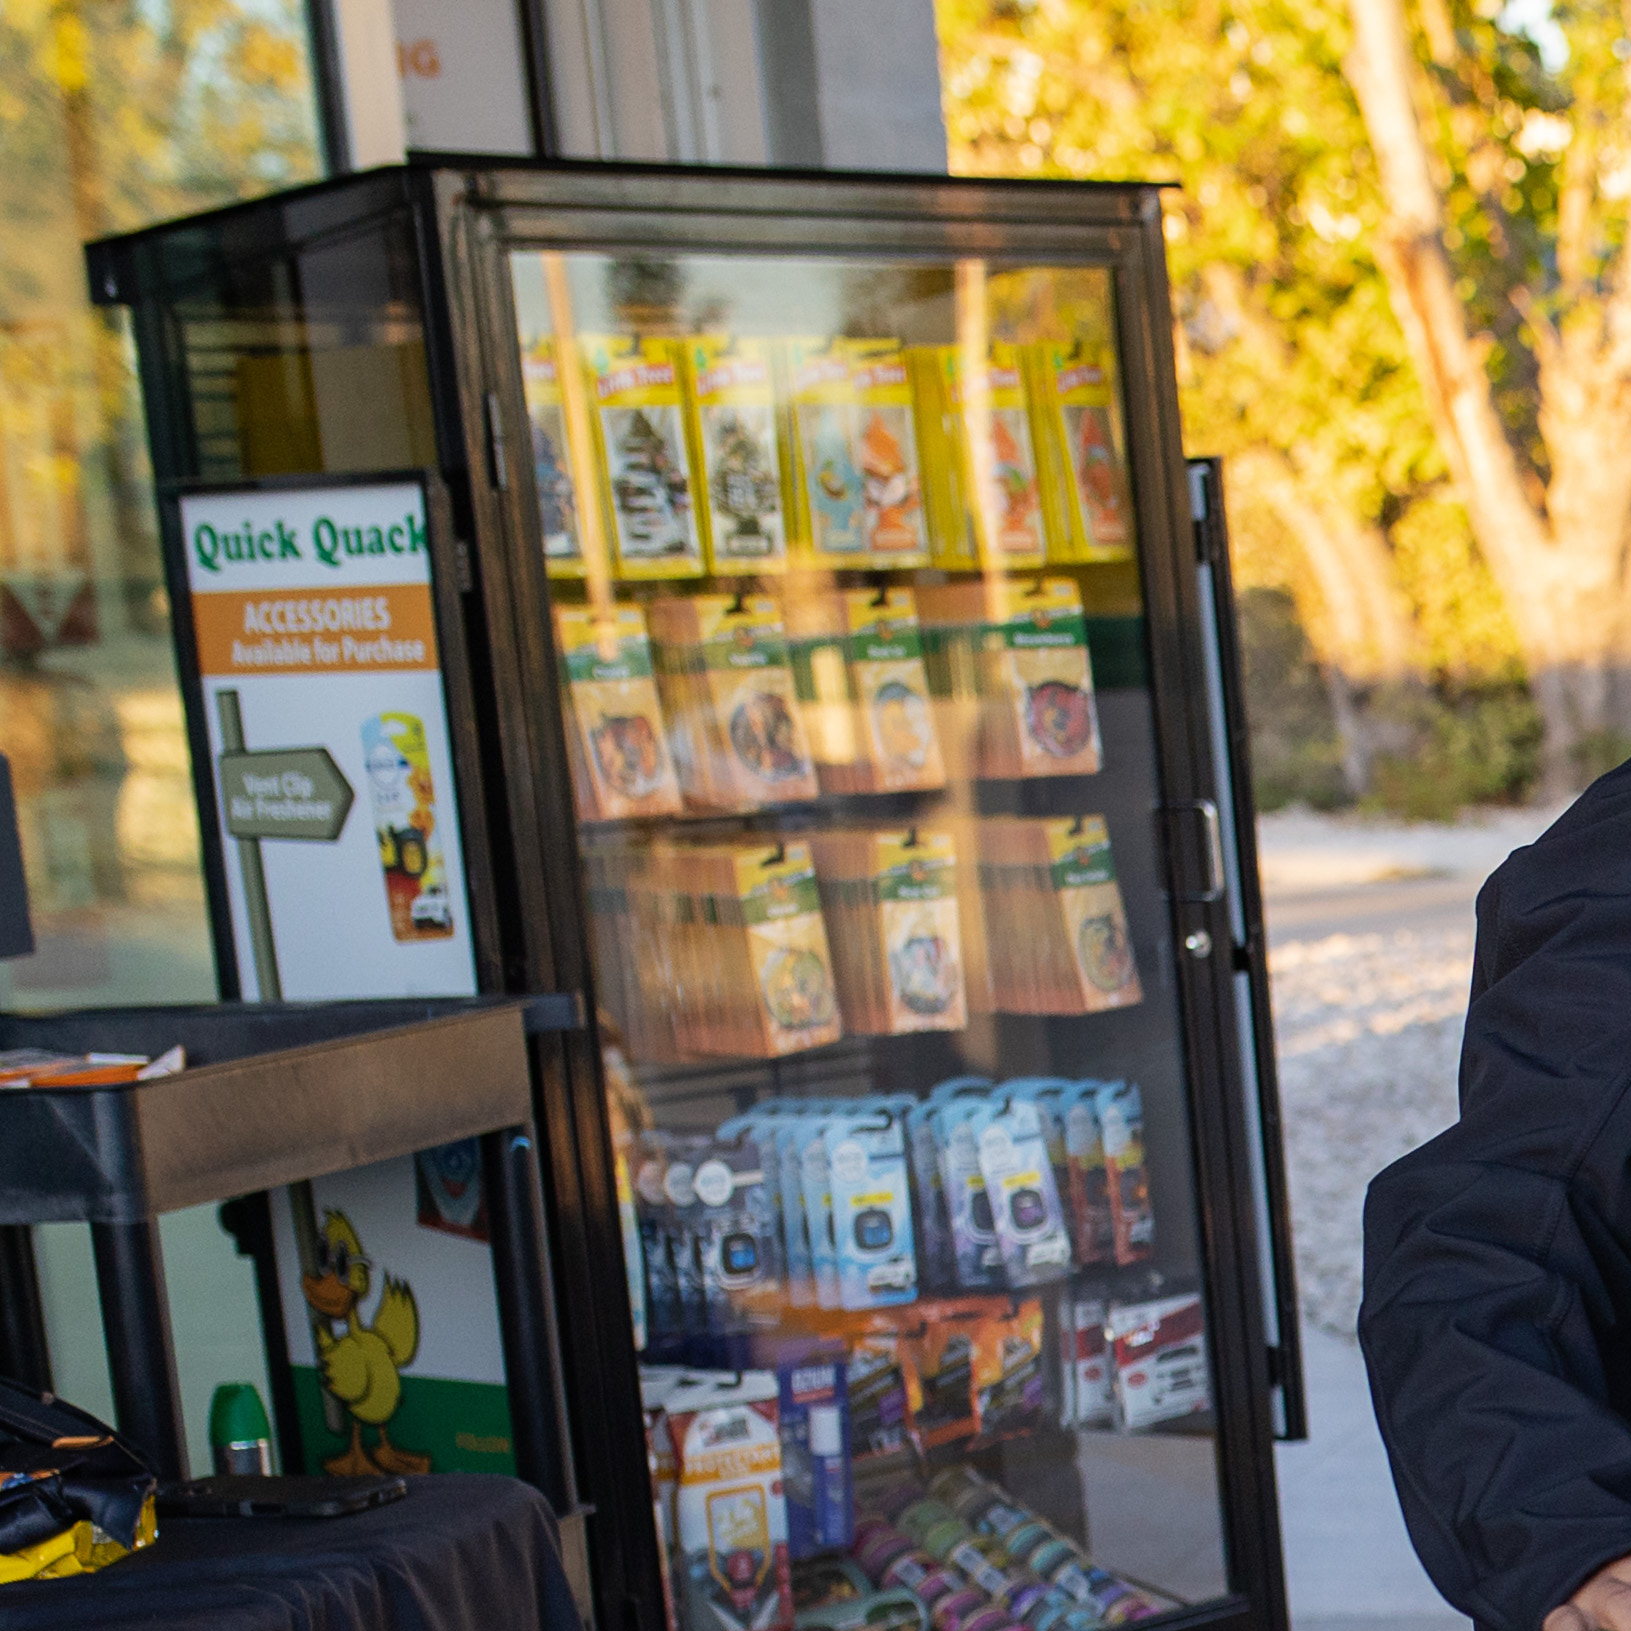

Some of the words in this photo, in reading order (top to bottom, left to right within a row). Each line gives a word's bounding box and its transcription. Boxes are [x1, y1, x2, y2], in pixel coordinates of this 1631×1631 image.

[194, 521, 301, 571] Quick
[312, 513, 428, 566] Quack
[244, 598, 391, 634] ACCESSORIES
[232, 640, 310, 665] Available
[314, 637, 339, 663] for
[344, 635, 425, 663] Purchase
